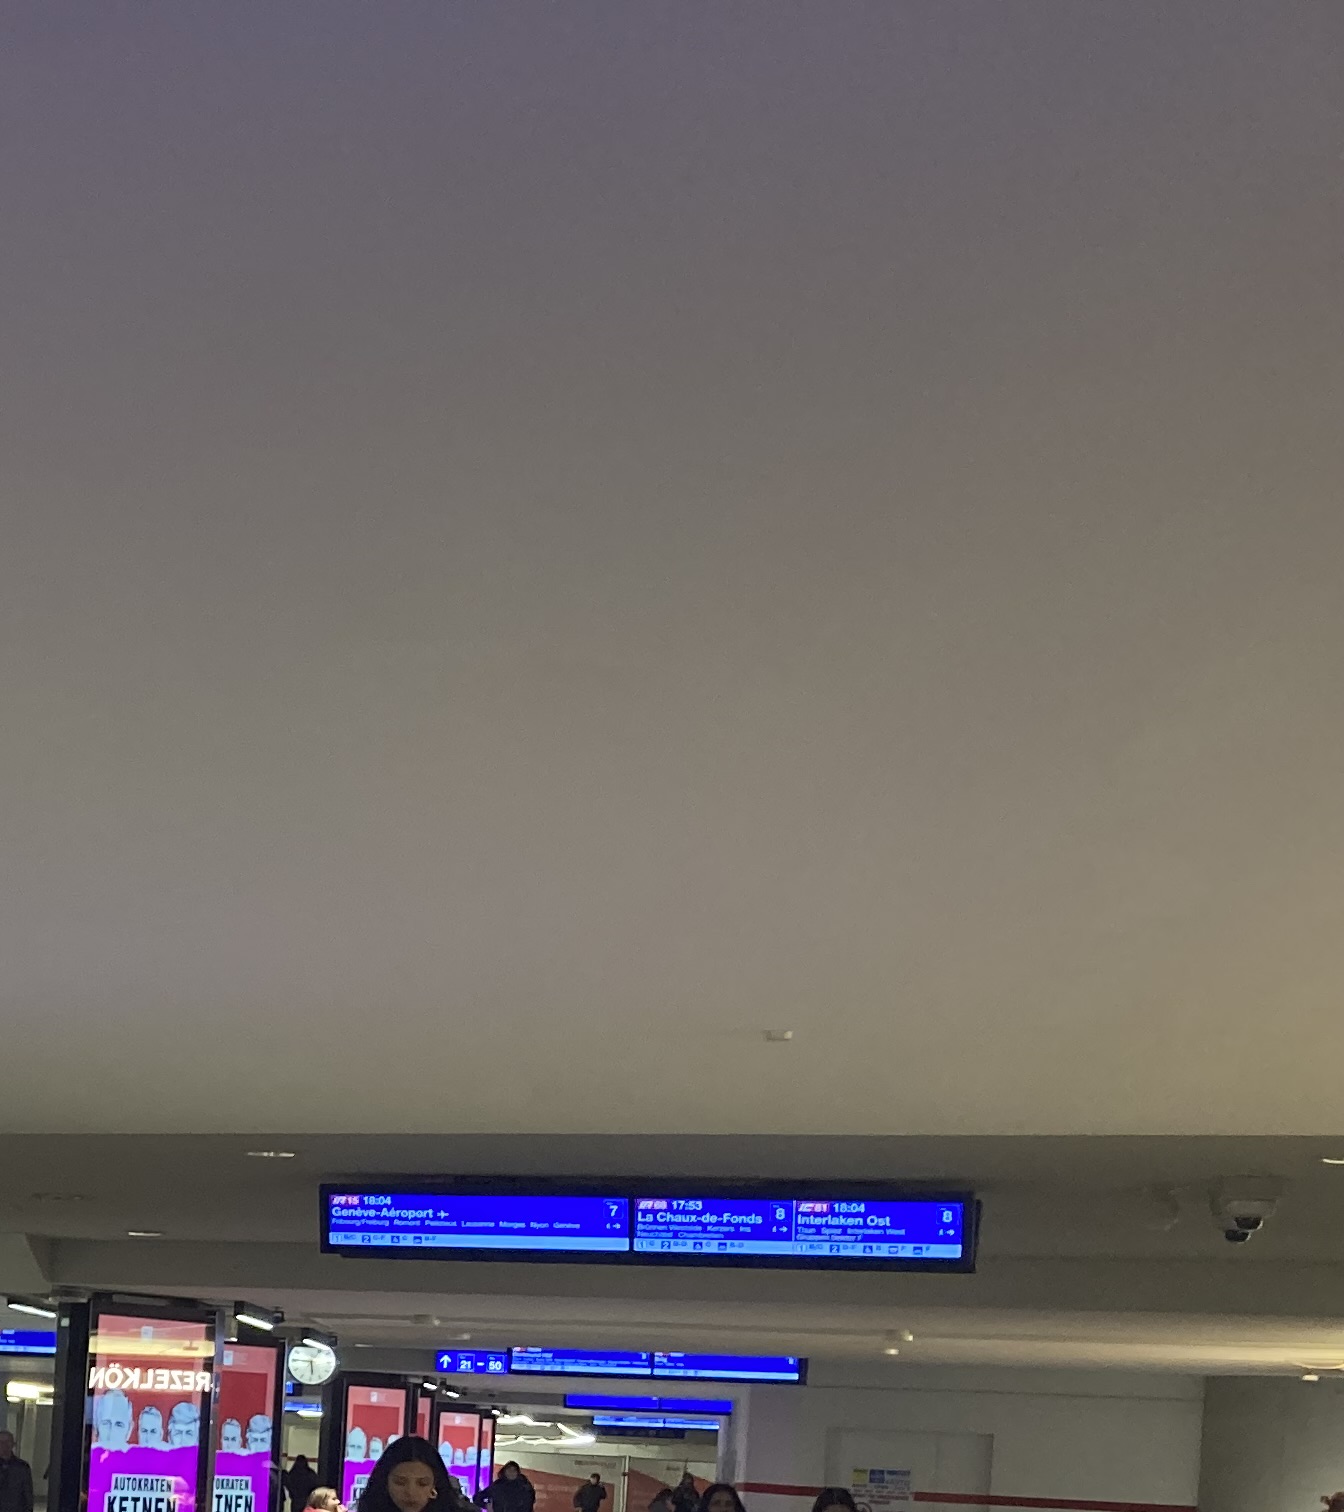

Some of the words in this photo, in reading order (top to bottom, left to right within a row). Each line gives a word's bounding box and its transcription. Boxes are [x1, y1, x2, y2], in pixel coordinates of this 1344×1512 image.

[363, 1196, 392, 1205] 18:04
[672, 1200, 703, 1211] 17:53
[332, 1207, 433, 1220] Genève-Aéroport
[609, 1205, 618, 1217] 7
[775, 1208, 785, 1220] 8
[833, 1203, 865, 1213] 18:04
[637, 1212, 653, 1222] La
[657, 1212, 763, 1224] Chaux-de-Fonds
[798, 1214, 863, 1226] Interlaken
[867, 1215, 891, 1226] Ost
[942, 1210, 952, 1222] 8
[460, 1360, 471, 1369] 21
[489, 1361, 502, 1370] 50
[113, 1476, 172, 1493] AUTOKRATEN
